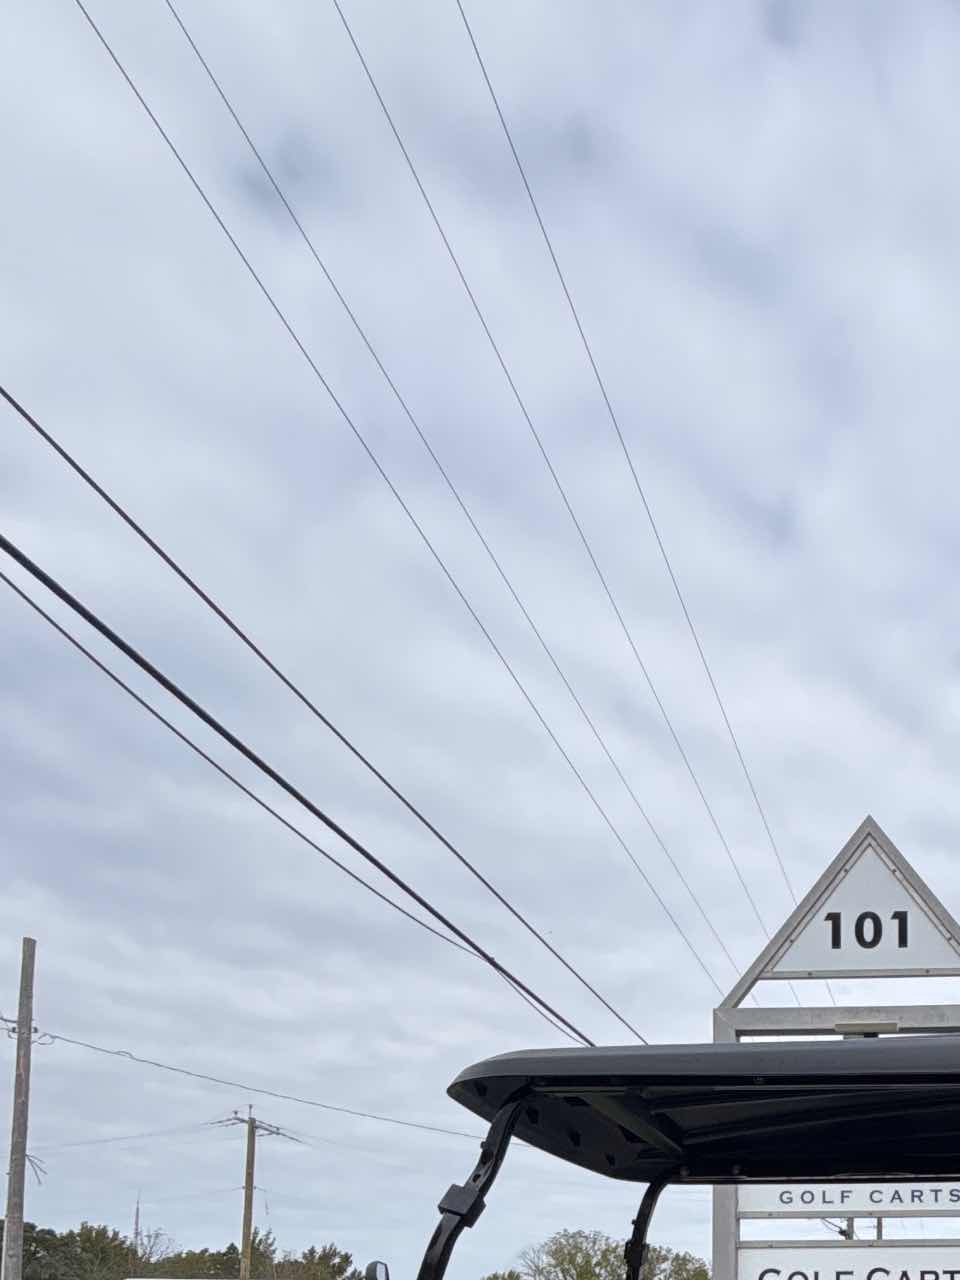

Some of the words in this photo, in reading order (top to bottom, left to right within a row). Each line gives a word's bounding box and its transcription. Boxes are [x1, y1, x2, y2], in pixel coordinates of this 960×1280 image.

[824, 910, 908, 949] 101
[779, 1190, 853, 1205] GOLF
[869, 1188, 960, 1204] CARTS
